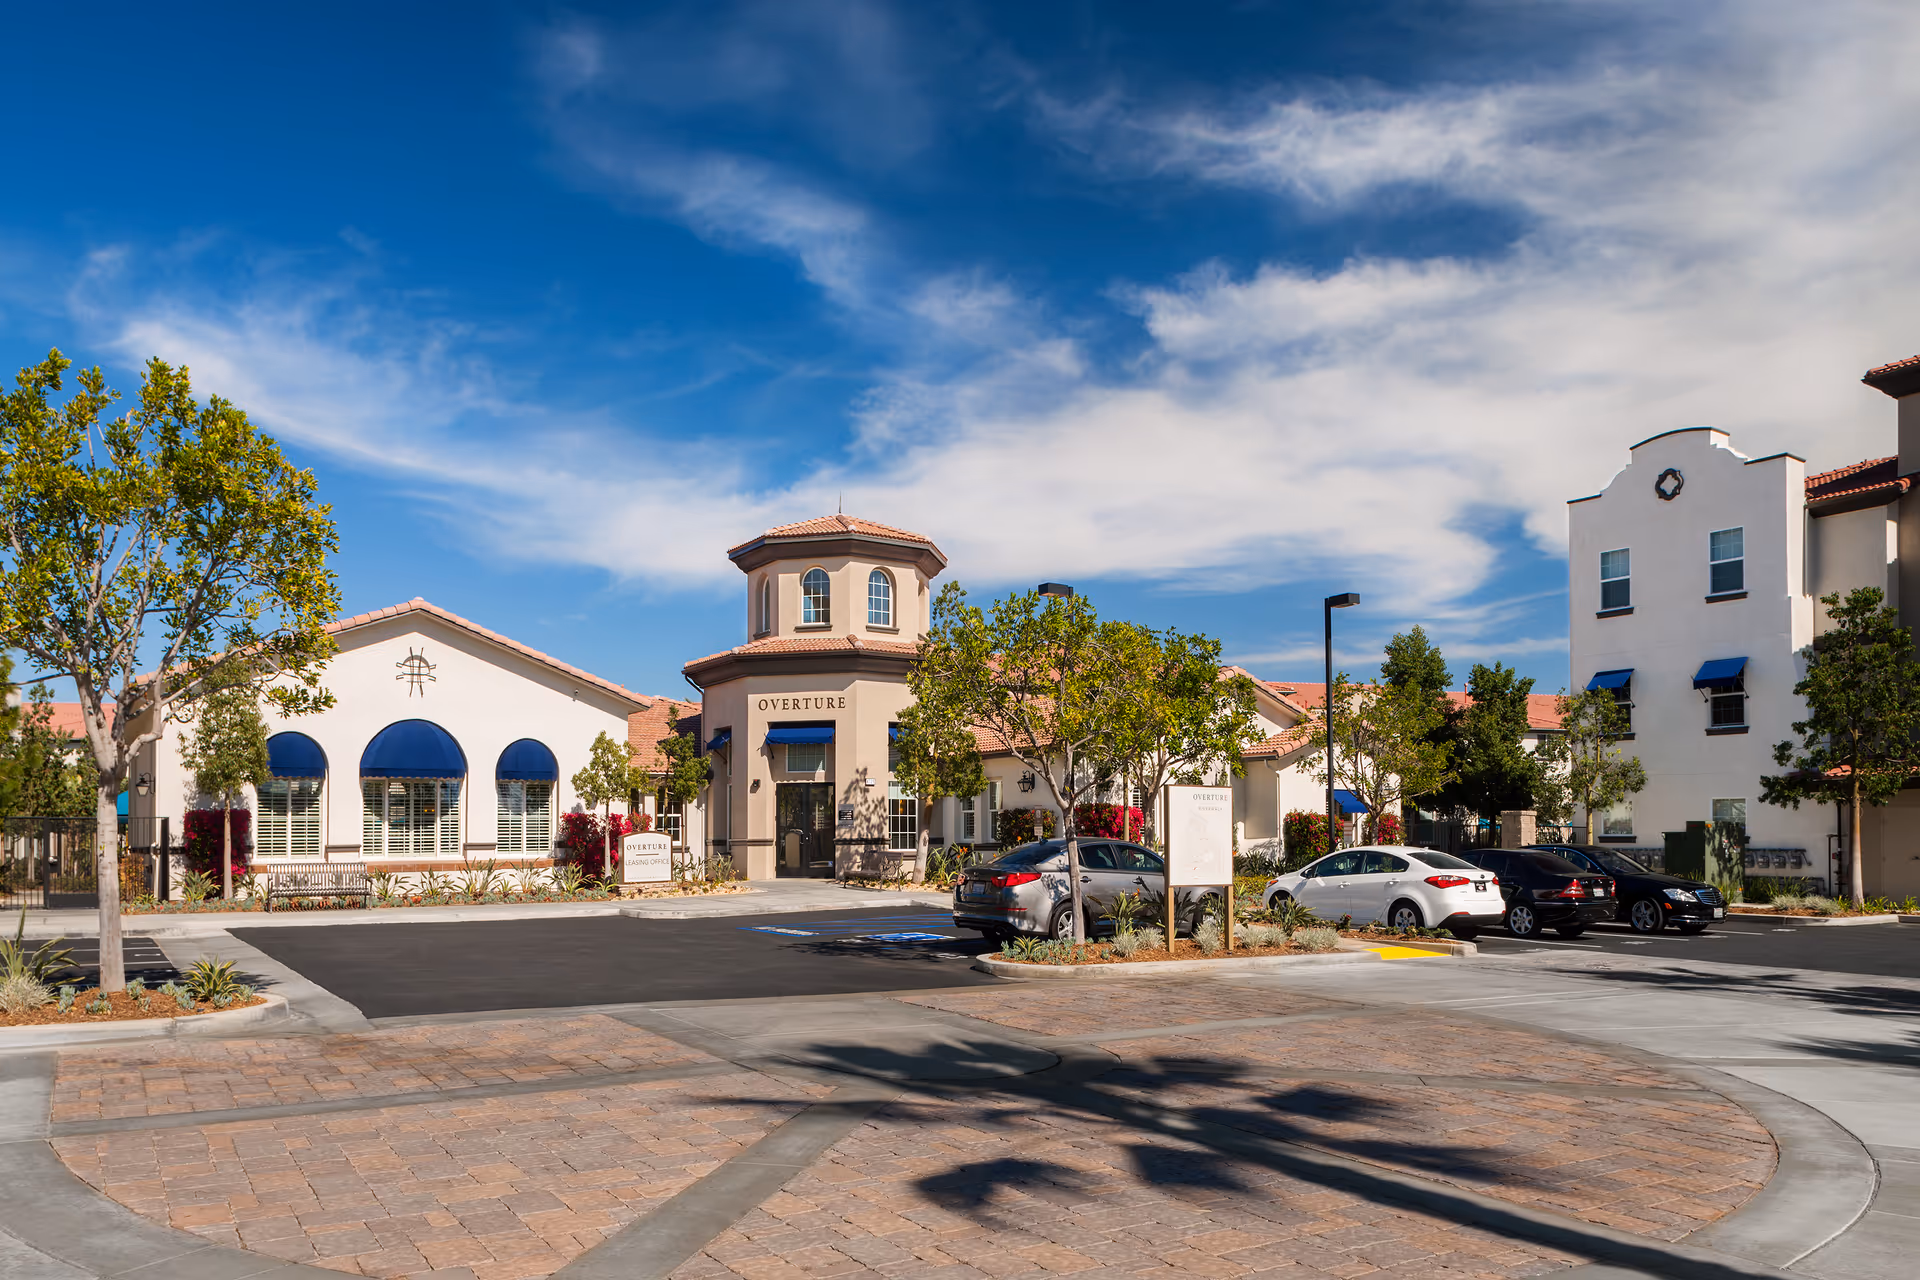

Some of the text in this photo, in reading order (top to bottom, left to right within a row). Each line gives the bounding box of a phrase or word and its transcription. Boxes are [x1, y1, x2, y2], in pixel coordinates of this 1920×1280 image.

[758, 697, 846, 711] OVERTURE
[1192, 793, 1228, 801] OVERTURE
[626, 843, 667, 851] OVERTURE
